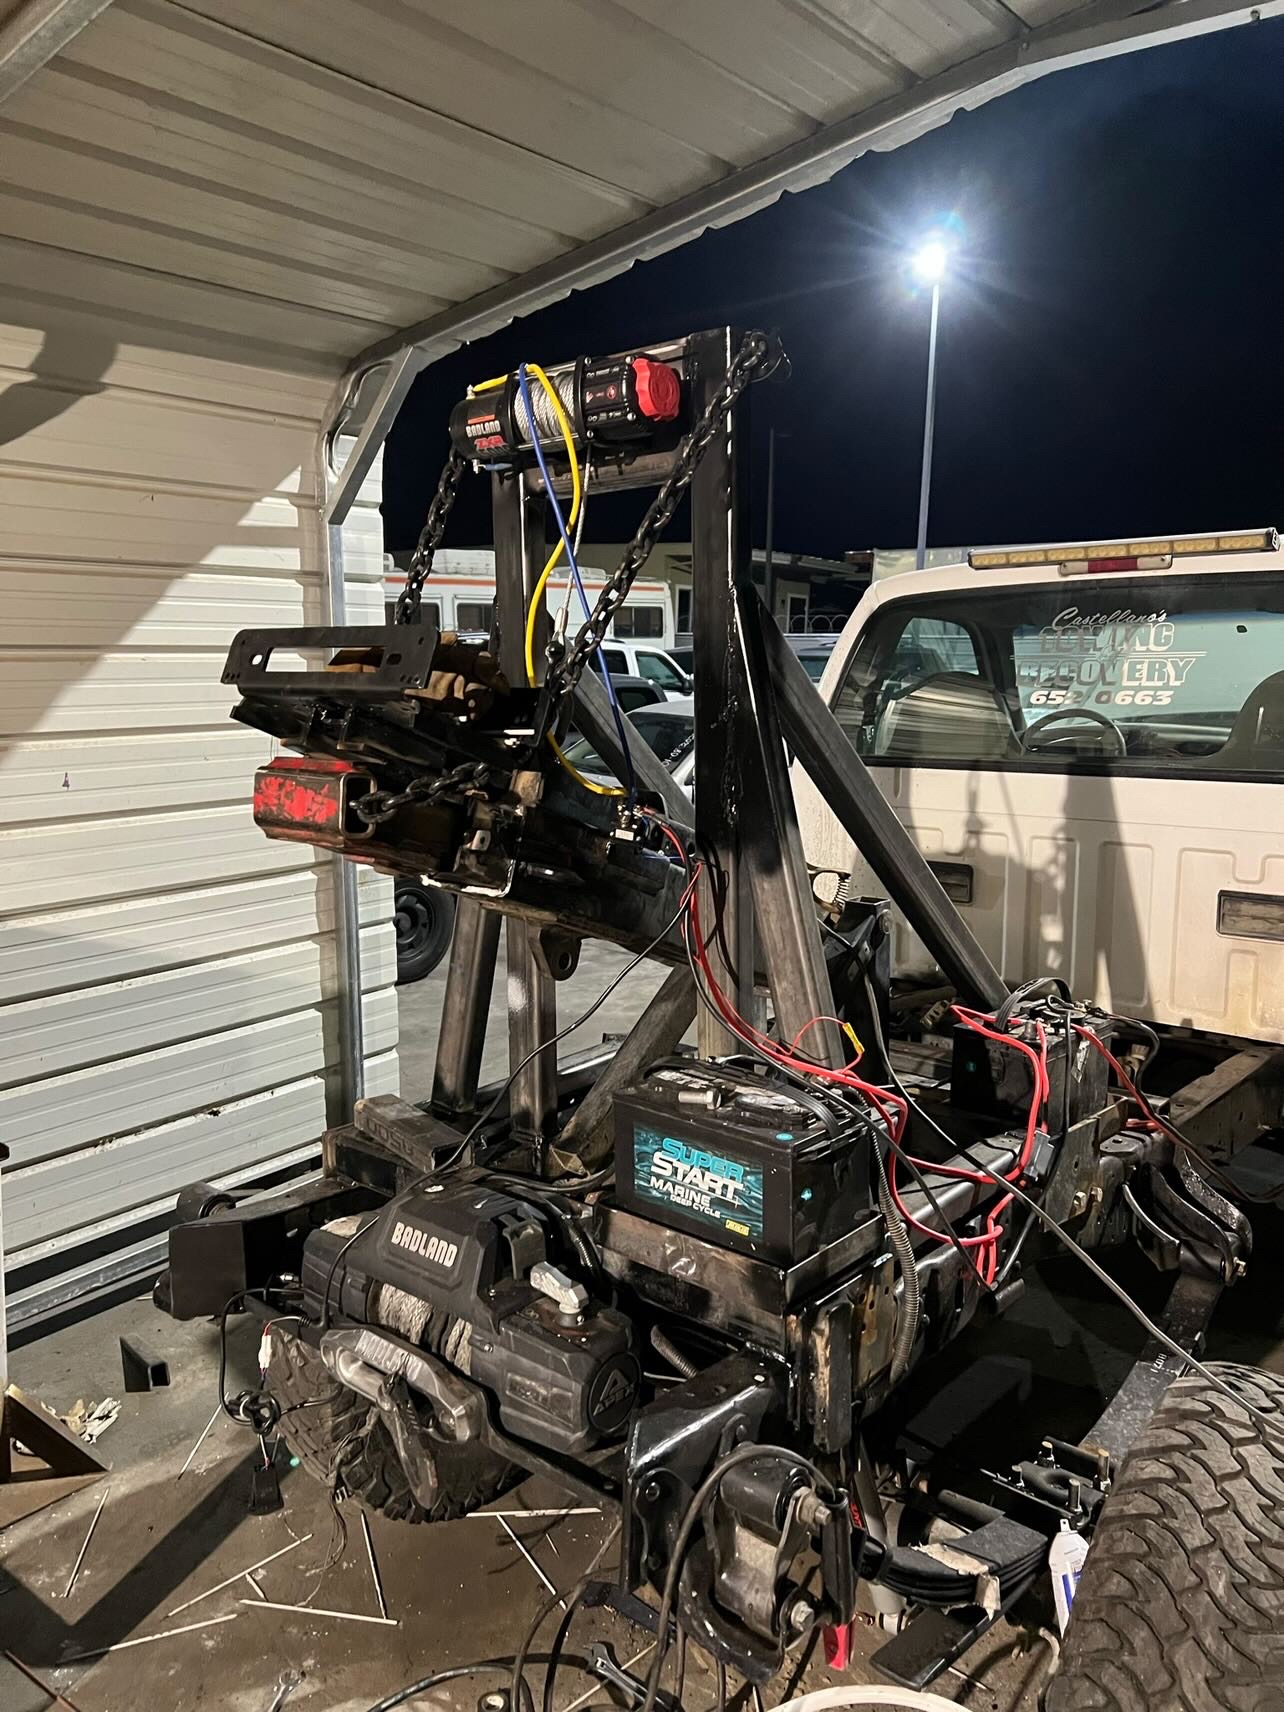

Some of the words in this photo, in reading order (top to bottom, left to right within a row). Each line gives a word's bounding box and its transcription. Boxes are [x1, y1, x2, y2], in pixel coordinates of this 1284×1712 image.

[465, 420, 501, 438] BADLAND
[1052, 607, 1168, 630] Castellano's
[1016, 657, 1195, 687] RECOVERY
[1029, 690, 1083, 705] 652
[1095, 690, 1174, 705] 0663
[662, 1137, 744, 1183] SUPER
[650, 1151, 744, 1200] START
[650, 1175, 712, 1207] MARINE
[670, 1193, 692, 1207] DEEP
[692, 1202, 721, 1219] CYCLE
[391, 1221, 458, 1268] BADLAND
